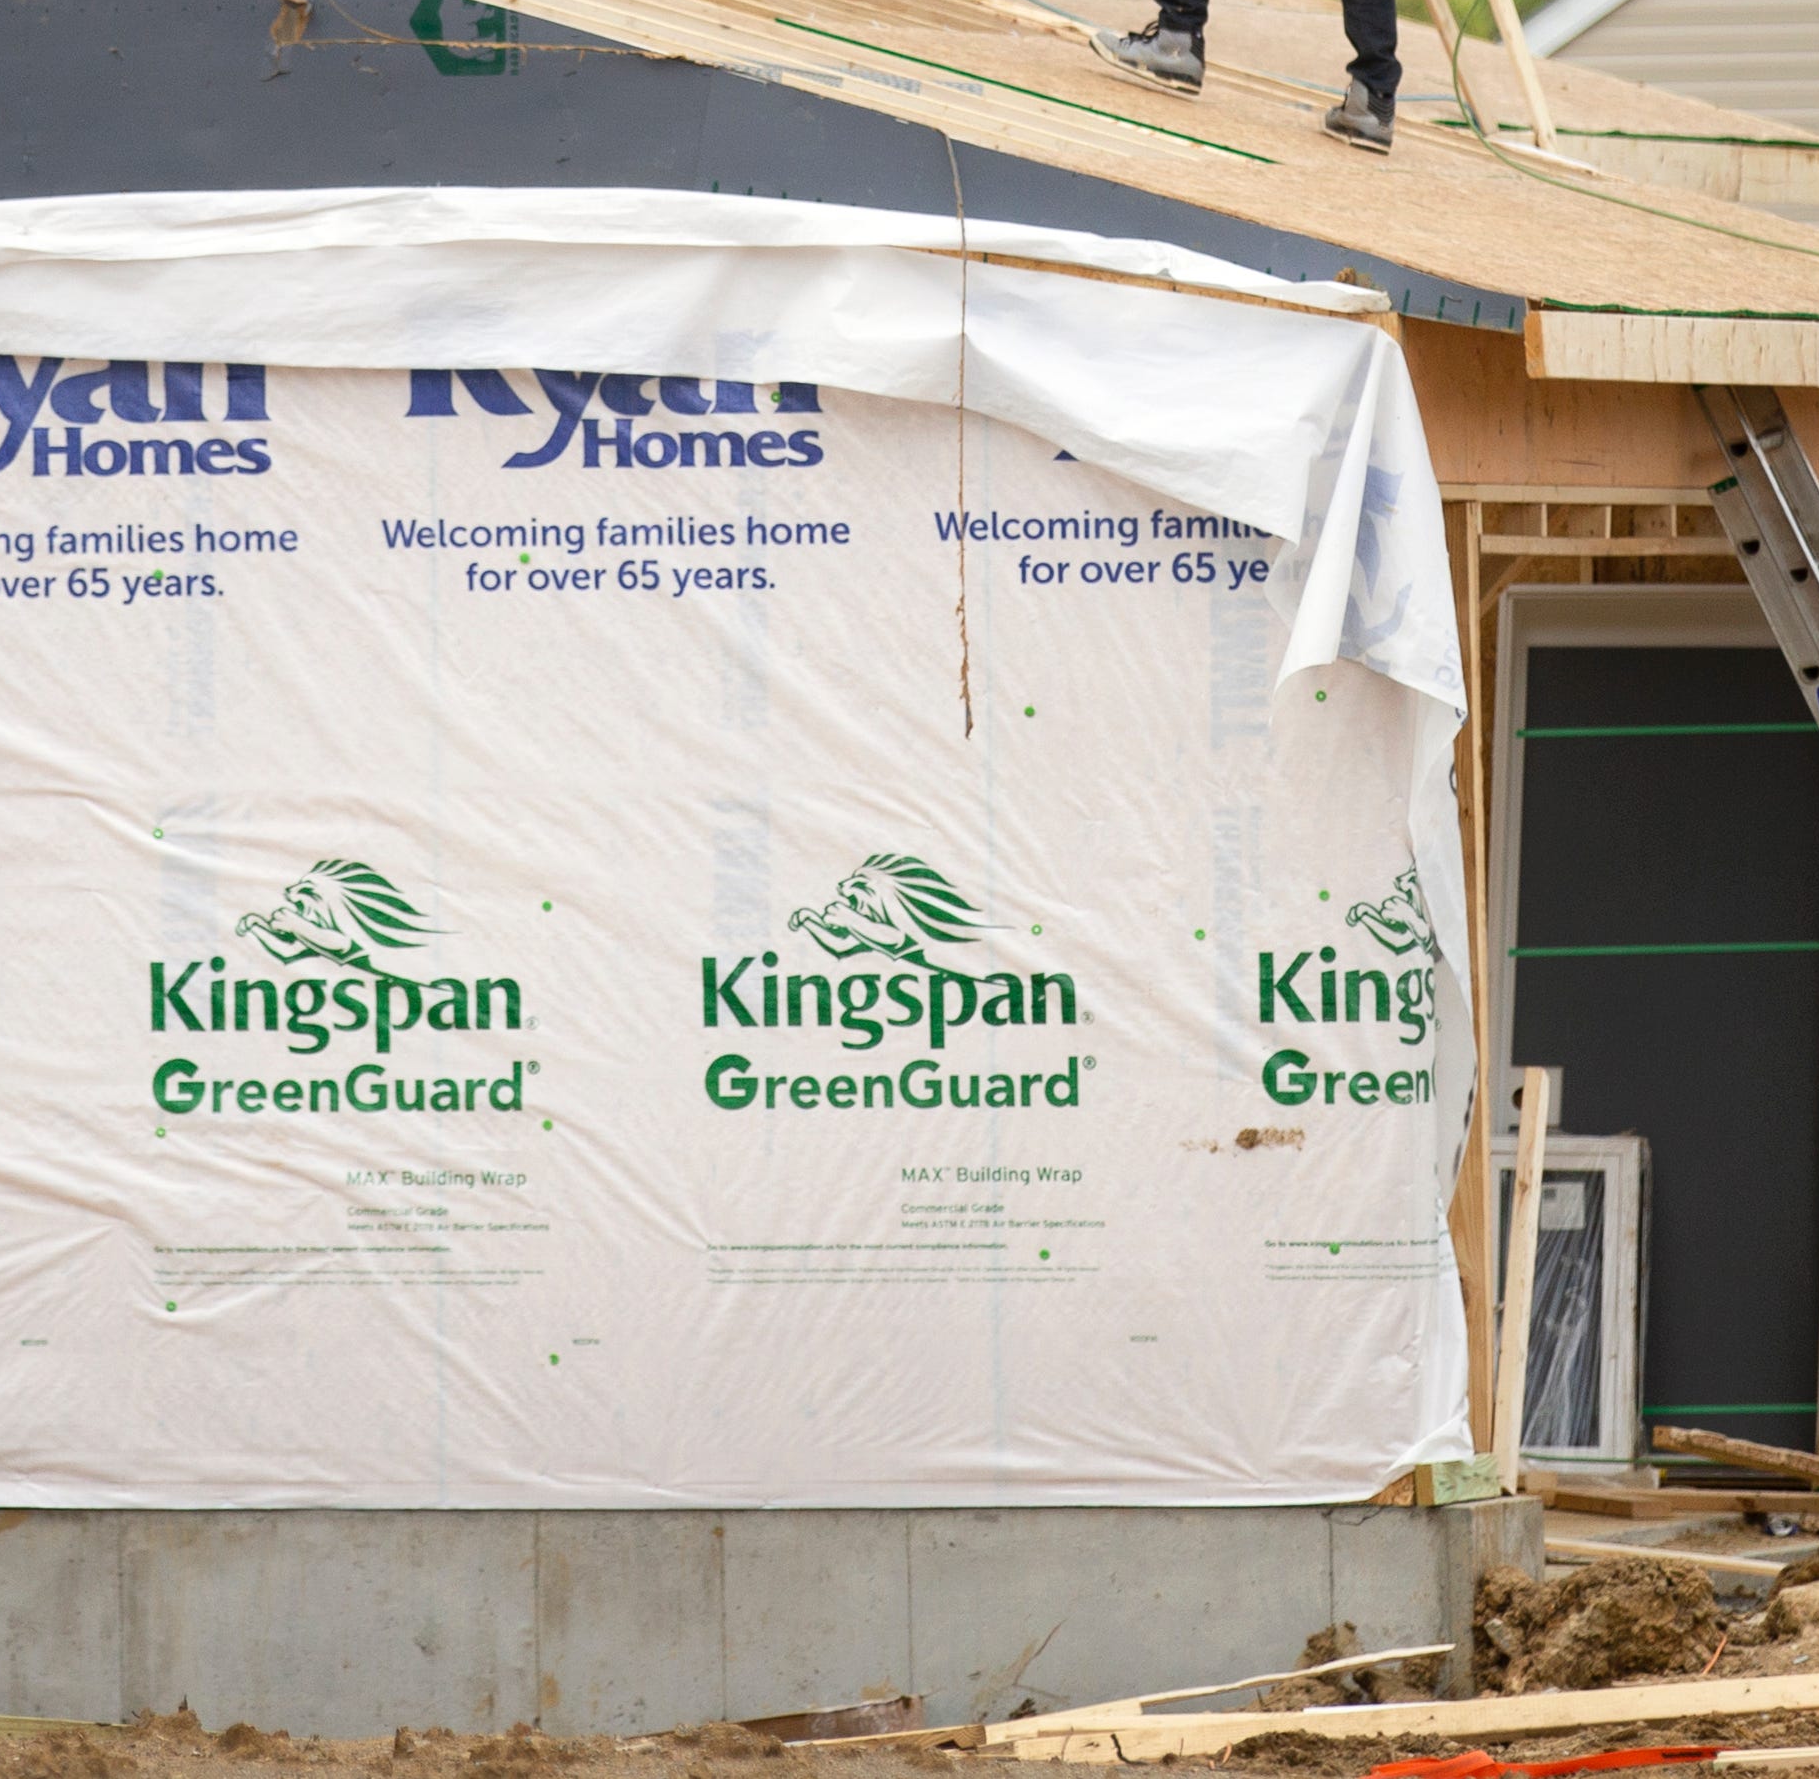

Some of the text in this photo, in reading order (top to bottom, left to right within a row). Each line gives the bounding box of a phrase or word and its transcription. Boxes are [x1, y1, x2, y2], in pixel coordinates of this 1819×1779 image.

[32, 427, 271, 476] Homes
[578, 413, 824, 468] Homes
[47, 524, 184, 554] families
[195, 524, 298, 552] home
[382, 516, 850, 554] Welcoming families home
[934, 509, 1139, 548] Welcoming
[68, 568, 110, 598] 65
[123, 574, 223, 605] years.
[466, 560, 775, 597] for over 65 years.
[1018, 553, 1071, 585] for
[1080, 557, 1161, 585] over
[1171, 551, 1217, 584] 65
[150, 955, 522, 1055] Kingspan
[702, 950, 1077, 1051] Kingspan
[152, 1058, 524, 1115] GreenGuard
[704, 1053, 1080, 1111] GreenGuard
[401, 1170, 475, 1188] Building
[481, 1171, 526, 1187] Wrap
[902, 1167, 1082, 1185] MAX Building Wrap
[900, 1203, 1005, 1214] Commercial Grade
